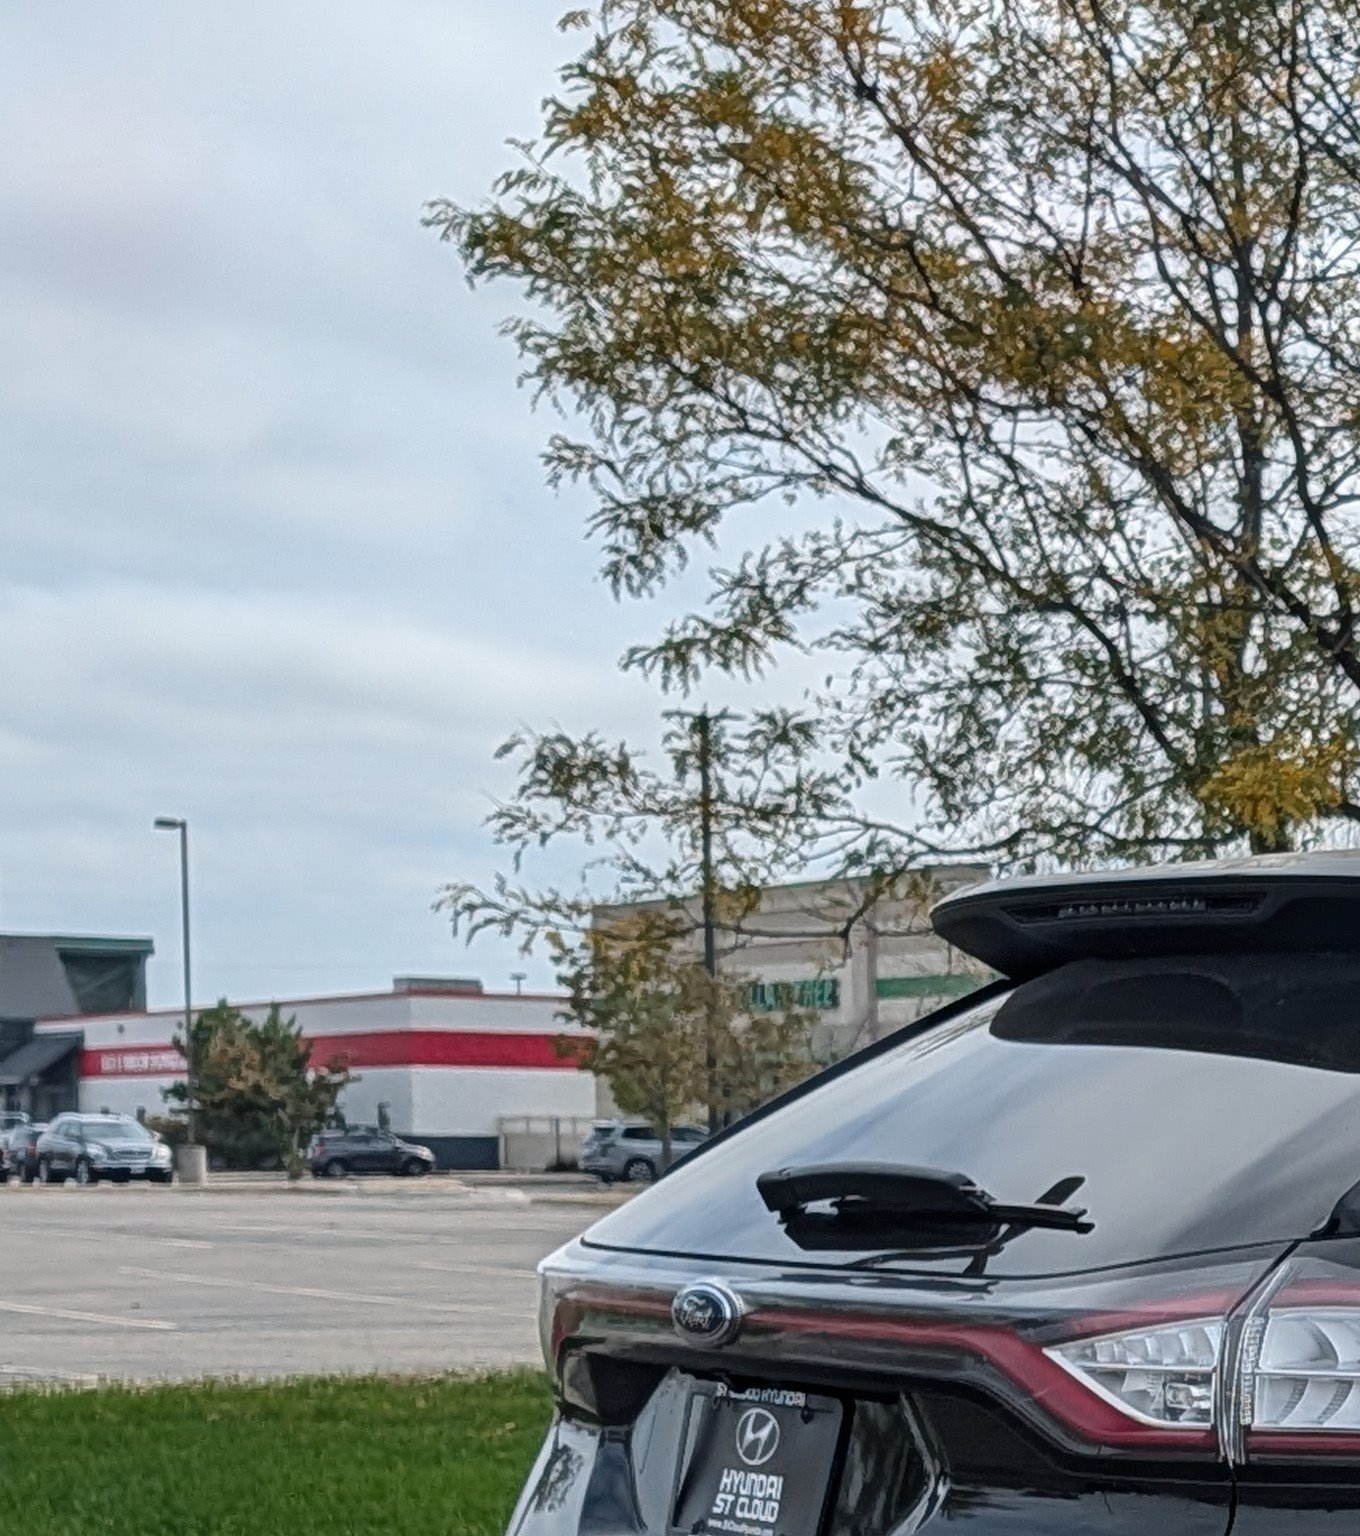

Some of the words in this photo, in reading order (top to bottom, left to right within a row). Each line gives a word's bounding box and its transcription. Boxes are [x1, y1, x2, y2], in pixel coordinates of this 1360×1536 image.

[719, 1468, 784, 1501] HYUNDAI
[712, 1493, 735, 1515] ST
[735, 1497, 780, 1524] CLOUD
